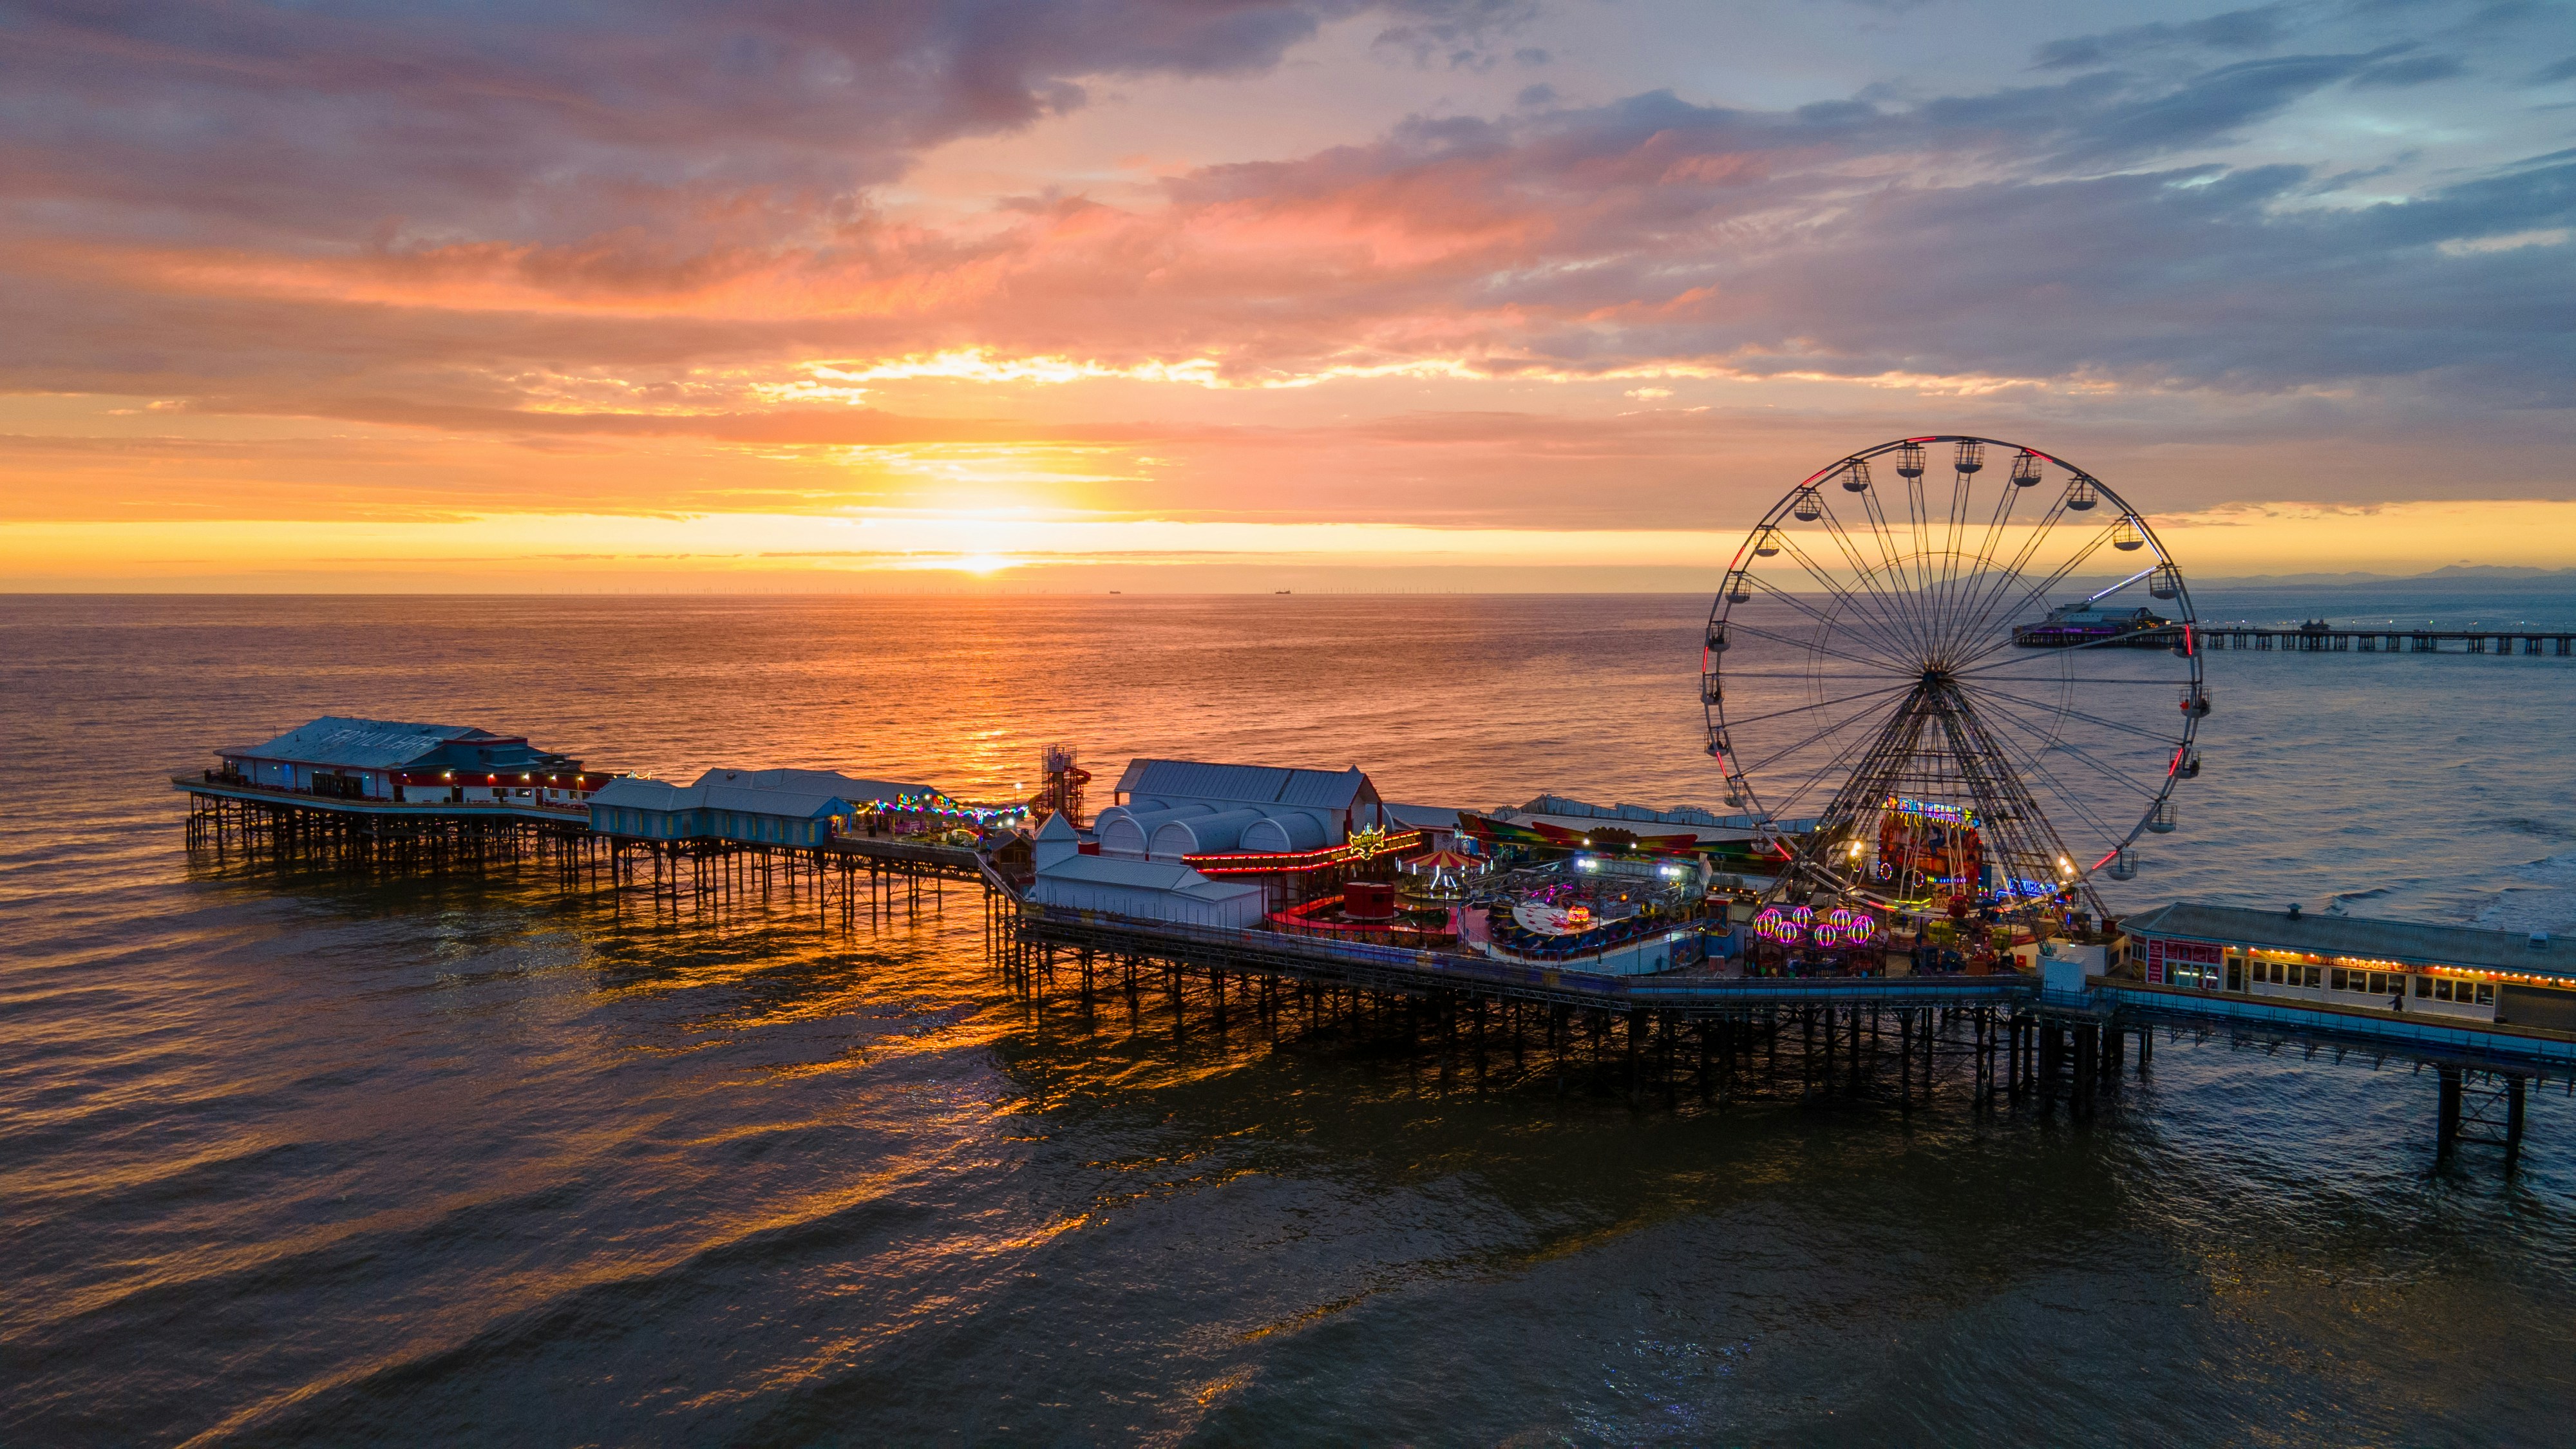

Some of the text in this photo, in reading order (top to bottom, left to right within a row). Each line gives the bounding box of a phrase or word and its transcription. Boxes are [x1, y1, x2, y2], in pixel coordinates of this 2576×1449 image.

[1353, 835, 1372, 848] PIRATES
[1388, 837, 1416, 848] AMUSEMENTS
[1316, 851, 1347, 862] AMUSEMENTS
[1202, 859, 1239, 867] WELCOME
[1252, 858, 1282, 867] CENTRAL
[2316, 956, 2424, 974] WHEELHOUSE CAFE
